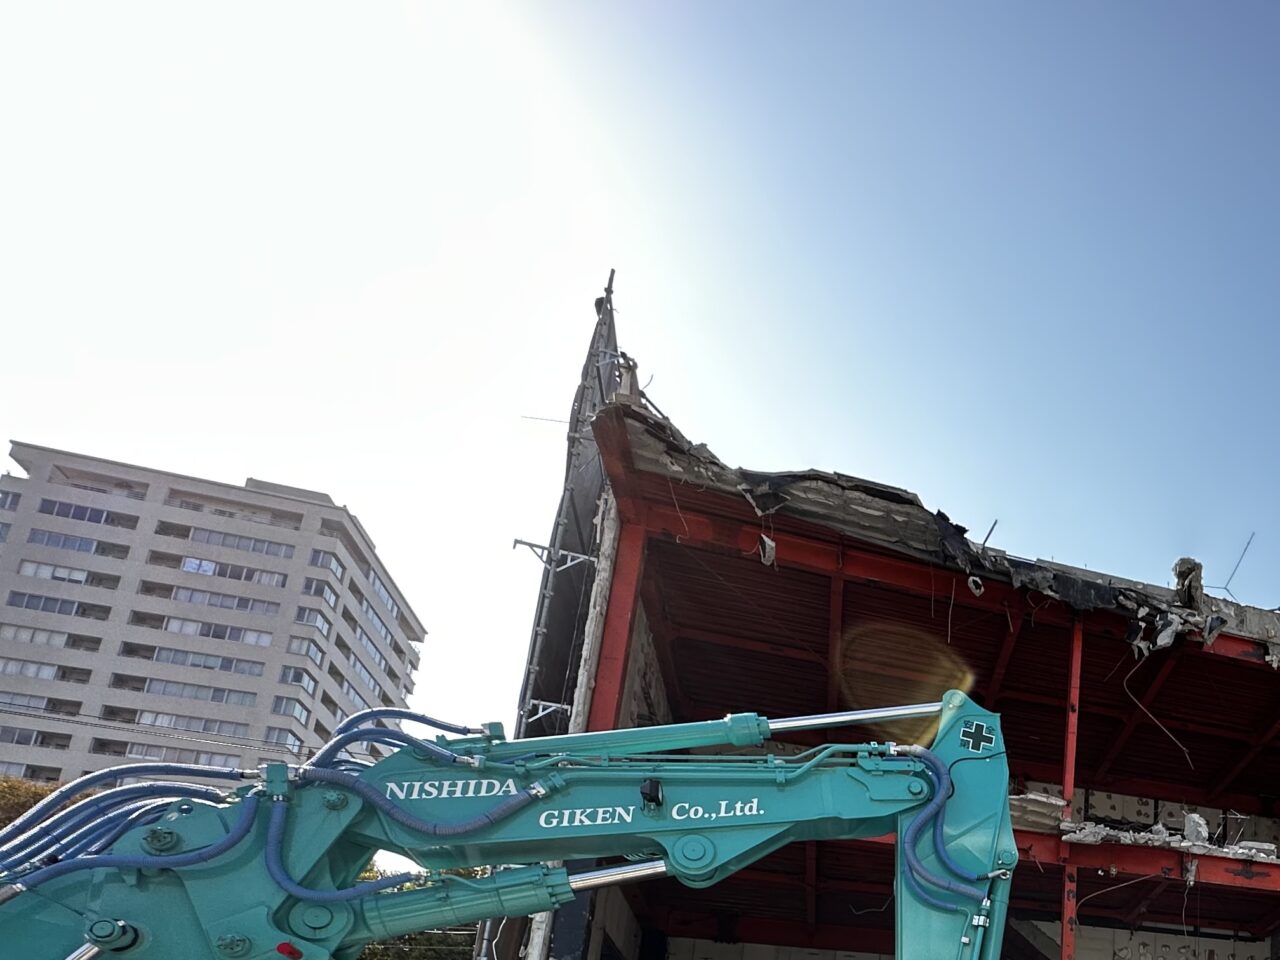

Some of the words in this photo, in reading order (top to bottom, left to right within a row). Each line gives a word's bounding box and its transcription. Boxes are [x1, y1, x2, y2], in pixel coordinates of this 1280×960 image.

[385, 778, 519, 800] NISHIDA
[538, 806, 636, 828] GIKEN
[671, 798, 765, 821] Co.,Ltd.
